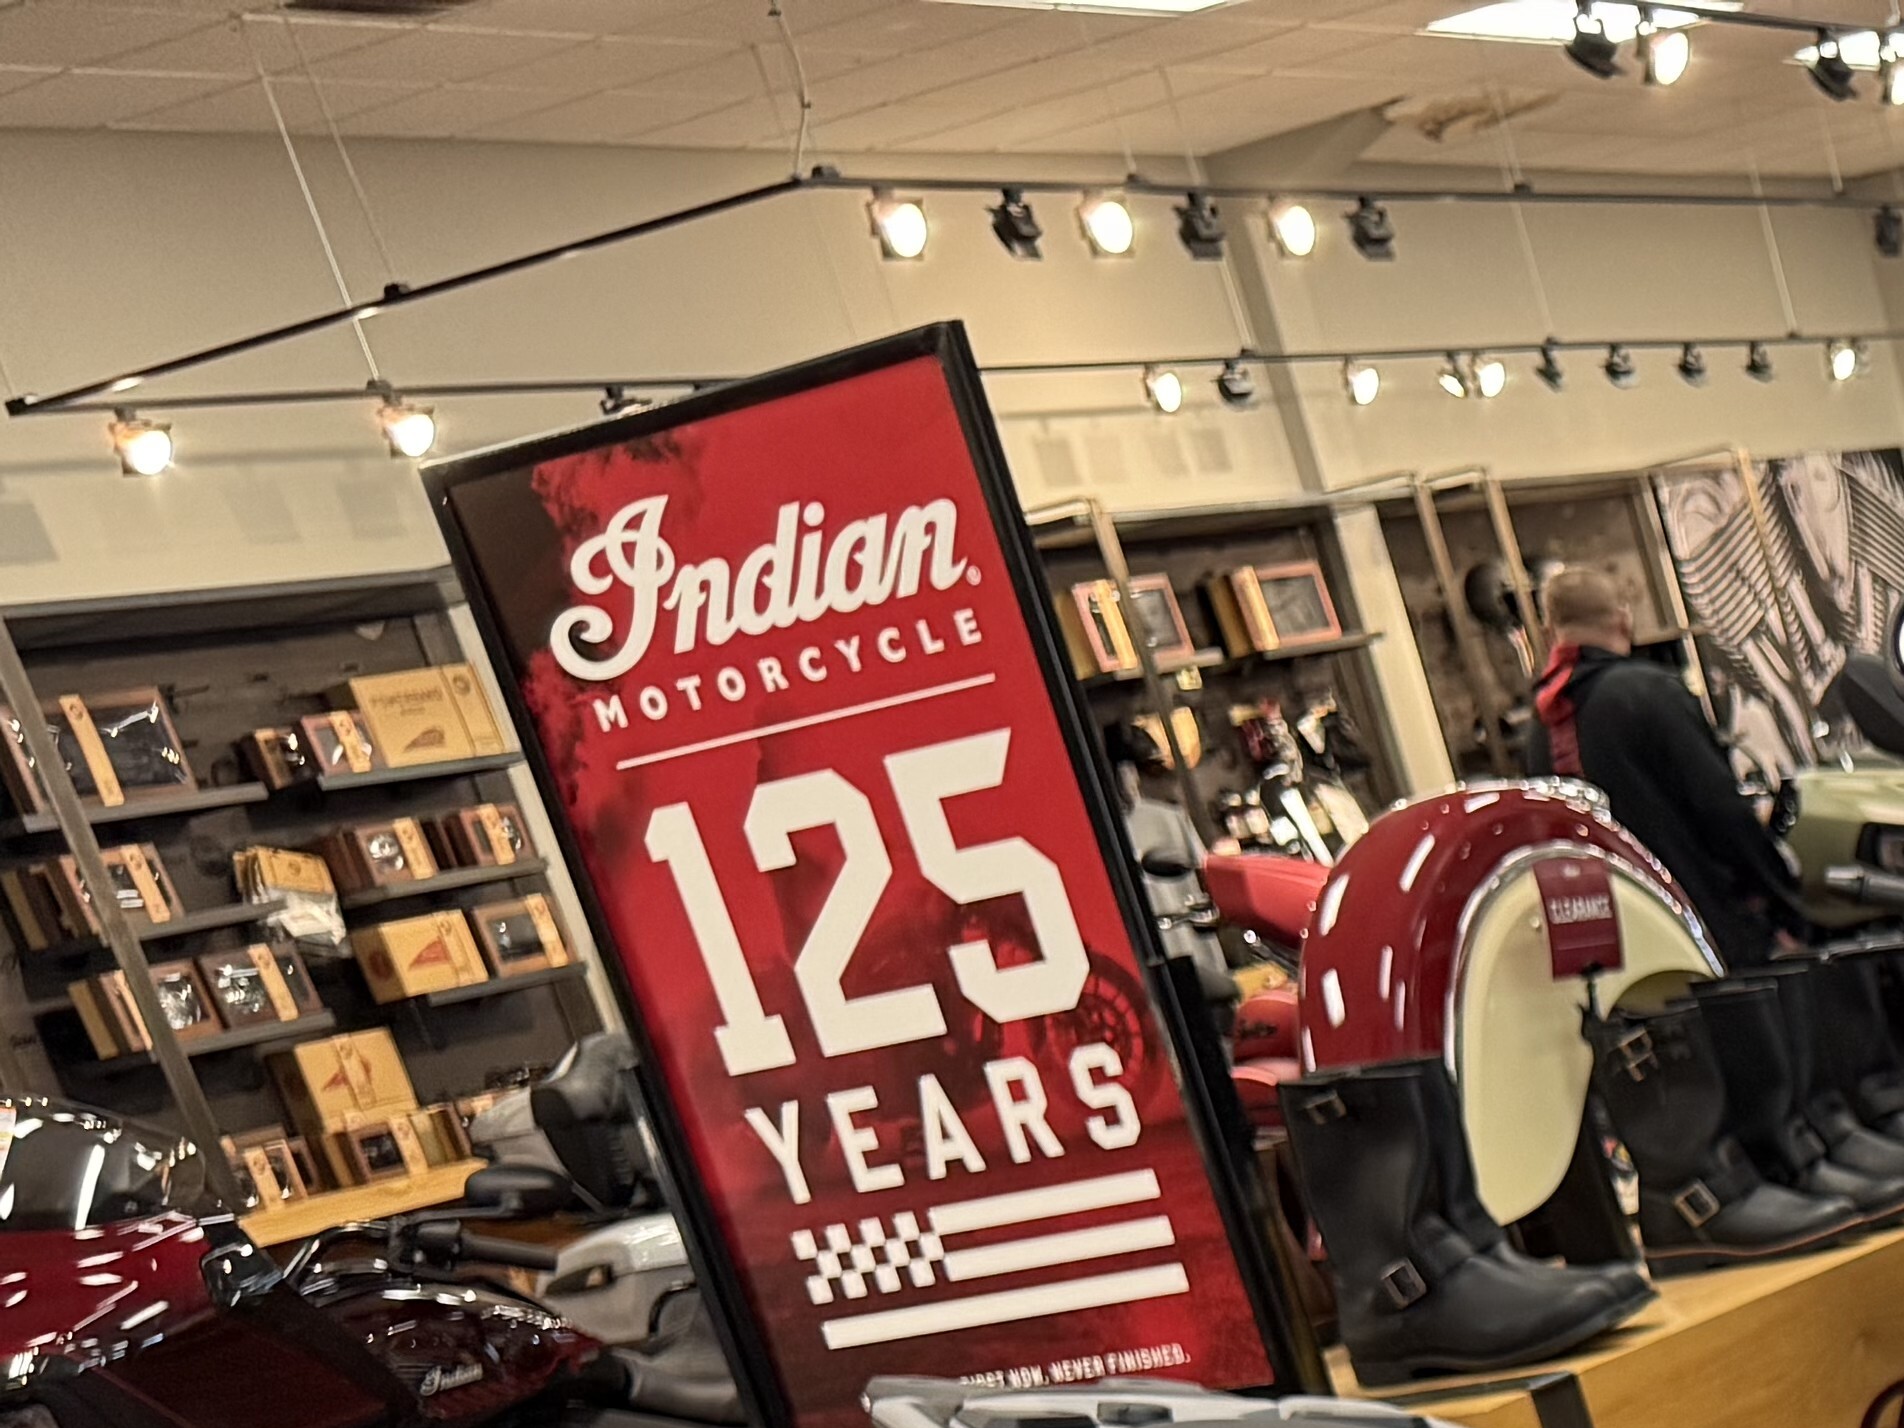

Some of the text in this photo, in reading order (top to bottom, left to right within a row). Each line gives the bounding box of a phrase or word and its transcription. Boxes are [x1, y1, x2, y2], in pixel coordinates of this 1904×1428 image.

[550, 494, 970, 682] Indian
[593, 608, 985, 734] MOTORCYCLE
[644, 728, 1091, 1077] 125
[744, 1041, 1142, 1205] YEARS
[1050, 1356, 1105, 1384] NEVER
